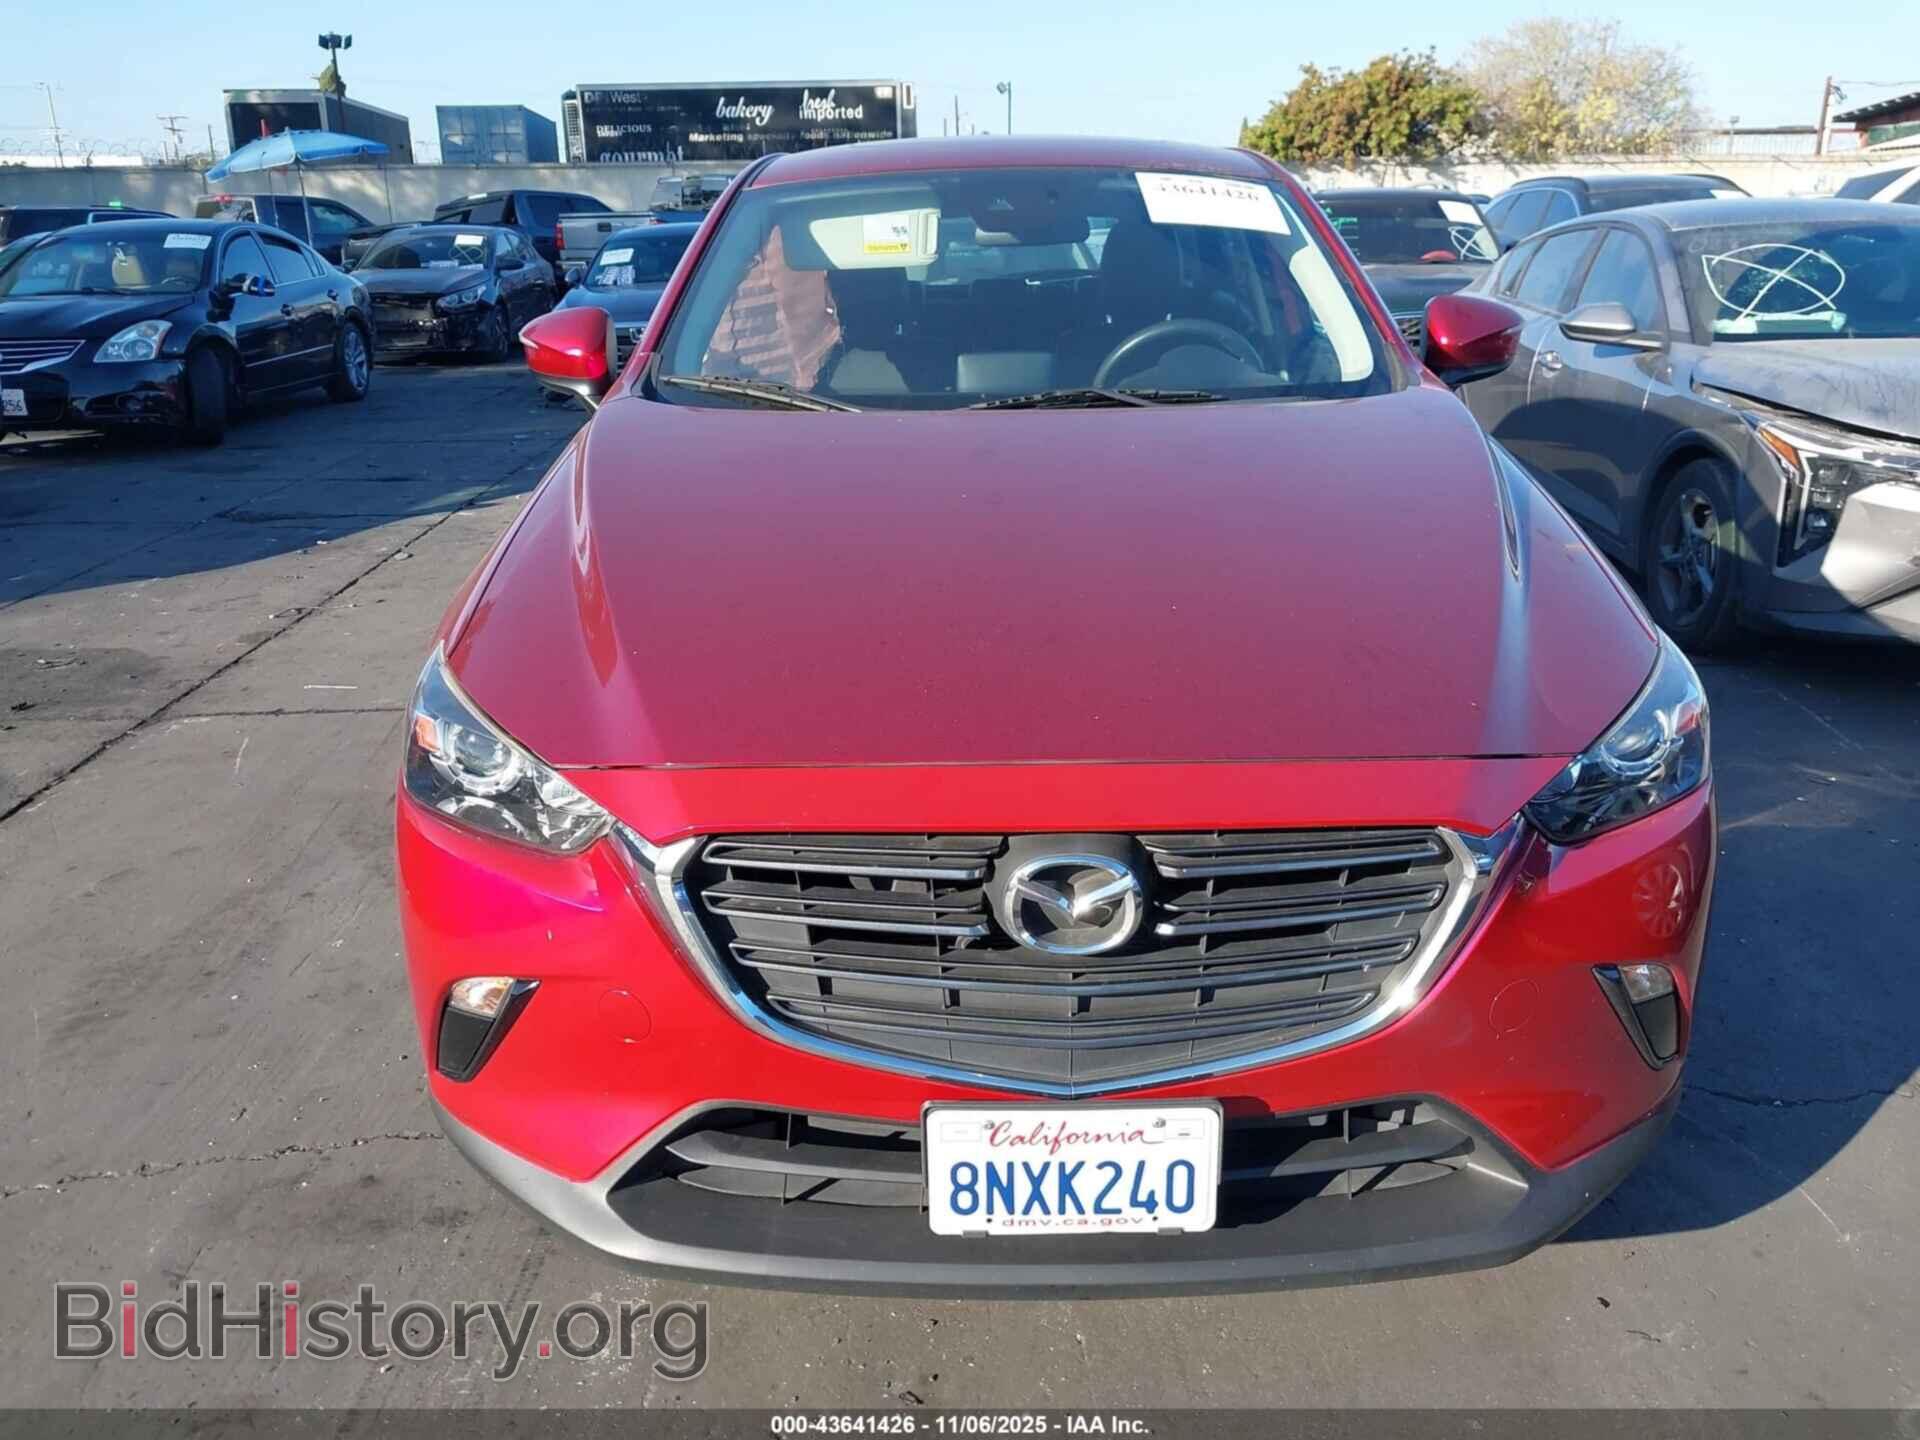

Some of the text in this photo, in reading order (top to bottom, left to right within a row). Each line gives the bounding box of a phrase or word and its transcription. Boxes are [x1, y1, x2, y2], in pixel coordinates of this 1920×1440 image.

[802, 89, 835, 110] fresh
[715, 96, 774, 126] bakery
[799, 104, 863, 121] imported
[688, 132, 744, 143] Marketing
[988, 1119, 1165, 1155] California
[949, 1159, 1196, 1216] 8NXK240
[1001, 1216, 1144, 1227] dmv.ca.gov
